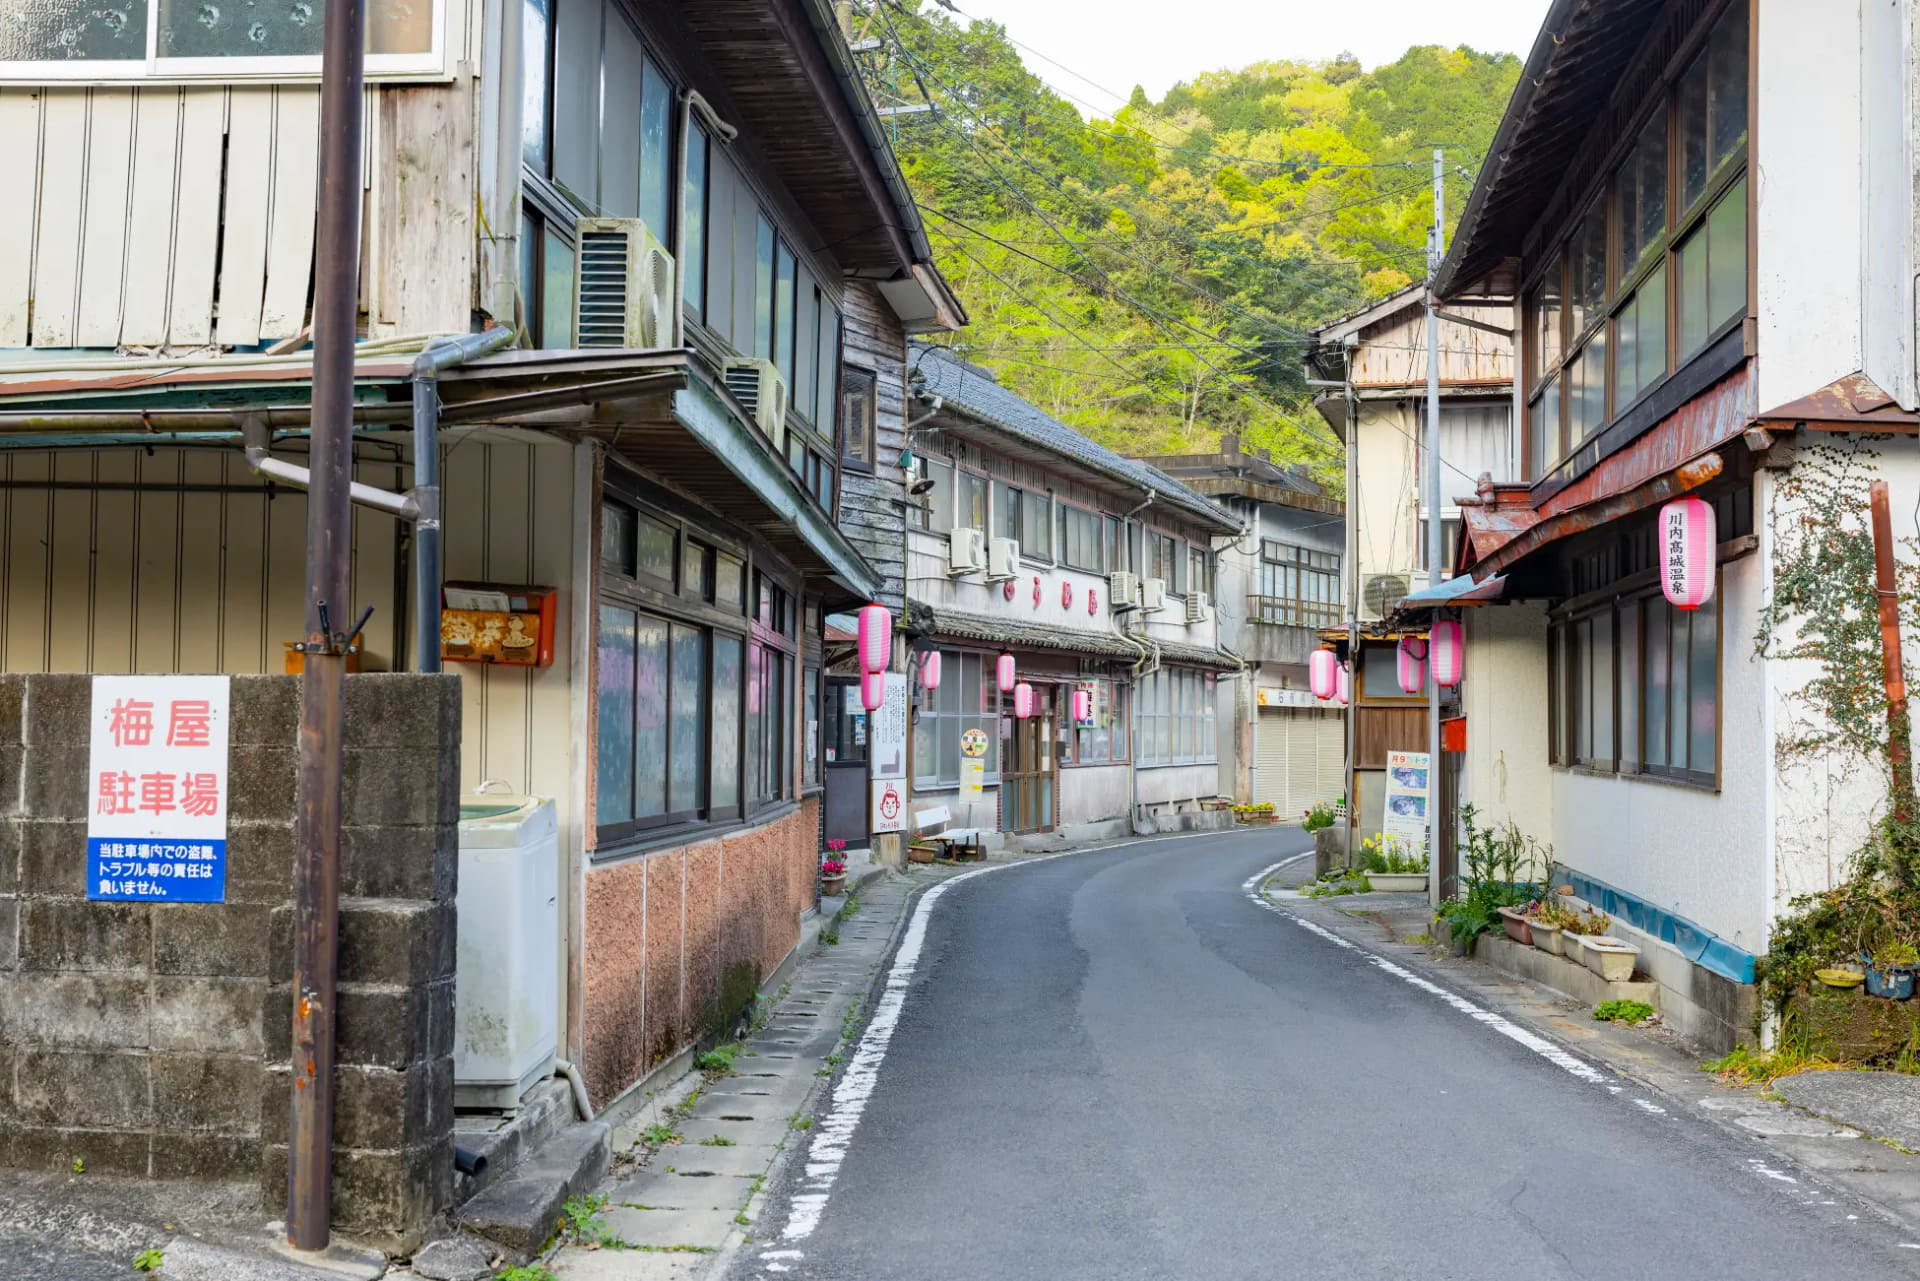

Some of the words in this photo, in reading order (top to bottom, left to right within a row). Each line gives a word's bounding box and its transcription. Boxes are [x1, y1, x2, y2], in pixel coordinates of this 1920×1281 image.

[109, 698, 211, 748] 梅屋
[97, 770, 219, 817] 駐車場
[99, 843, 218, 860] 当駐車場内での盗難、
[98, 862, 214, 879] トラブル等の責任は
[98, 879, 168, 896] 負いません。
